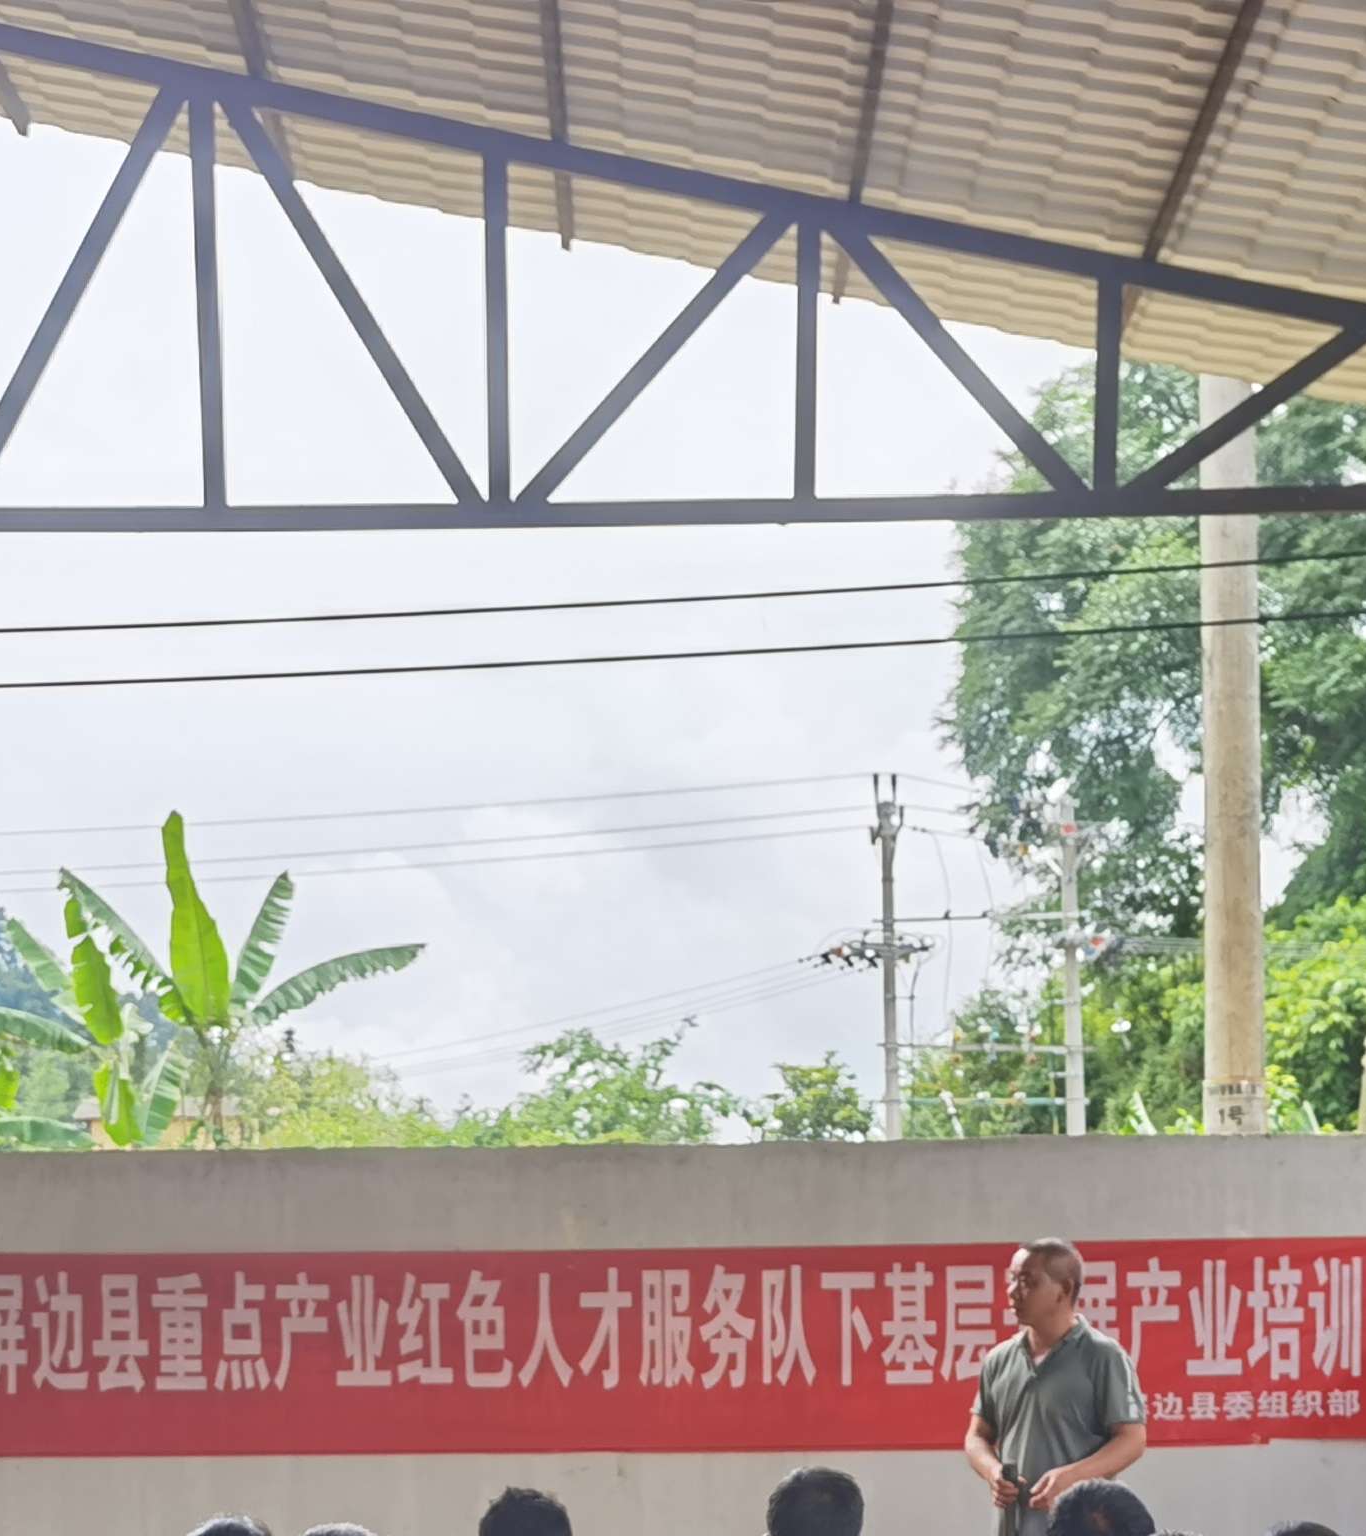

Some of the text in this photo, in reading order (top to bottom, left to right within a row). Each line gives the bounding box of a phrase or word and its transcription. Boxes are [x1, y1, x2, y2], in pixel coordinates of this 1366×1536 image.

[1143, 1389, 1361, 1421] 边县委组织部
